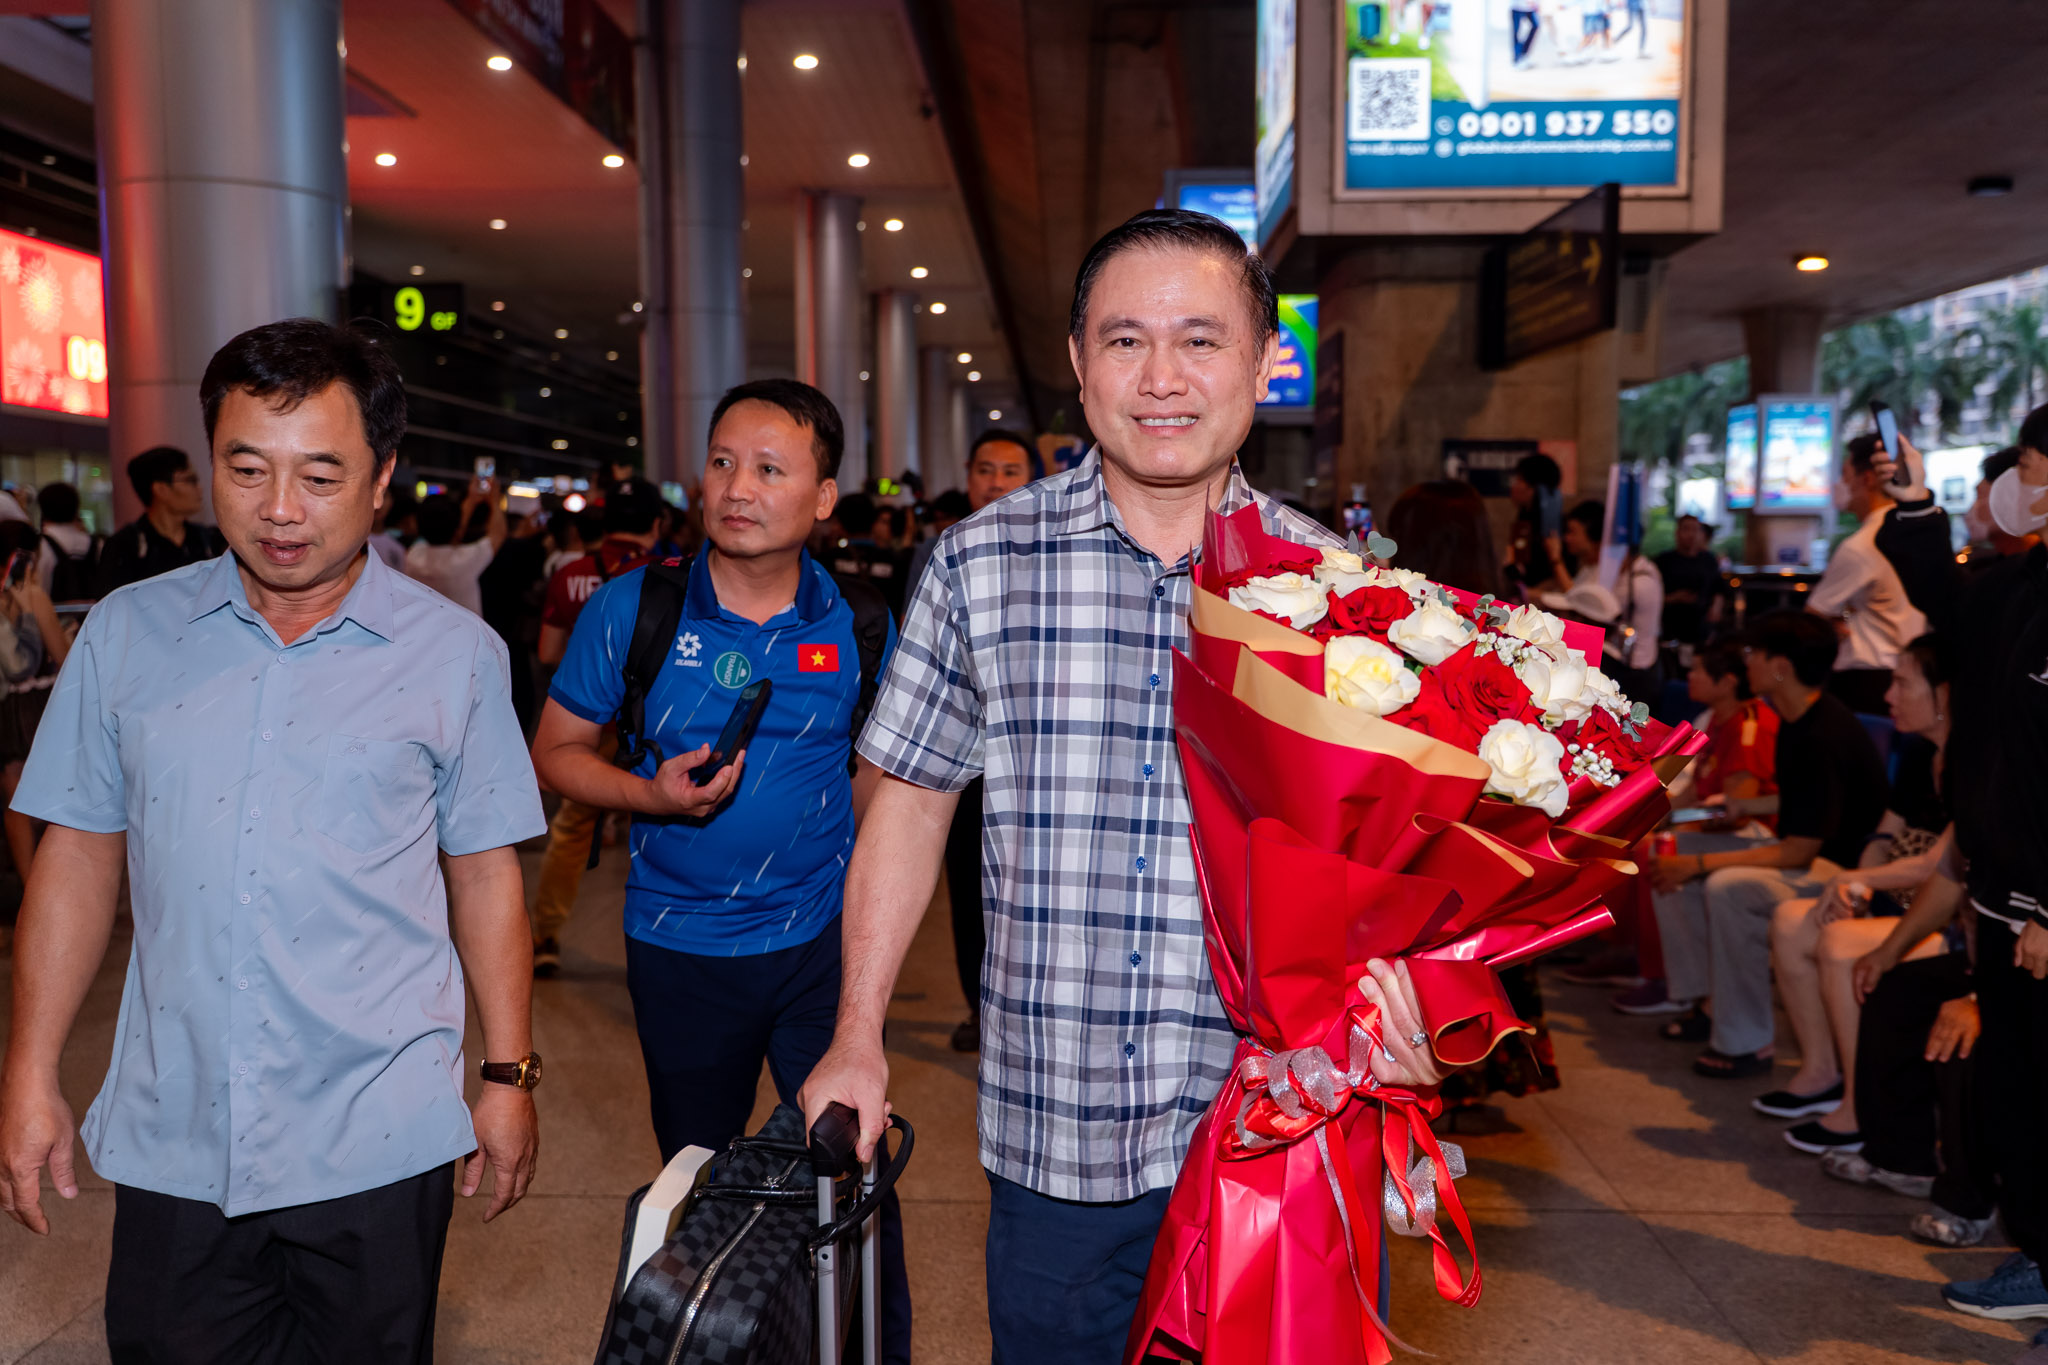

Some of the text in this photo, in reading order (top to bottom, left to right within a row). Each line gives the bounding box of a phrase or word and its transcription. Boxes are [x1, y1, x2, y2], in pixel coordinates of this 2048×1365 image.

[1457, 108, 1676, 138] 0901 937 550
[394, 286, 425, 331] 9
[67, 335, 107, 383] 09
[723, 655, 737, 686] TRANSIT
